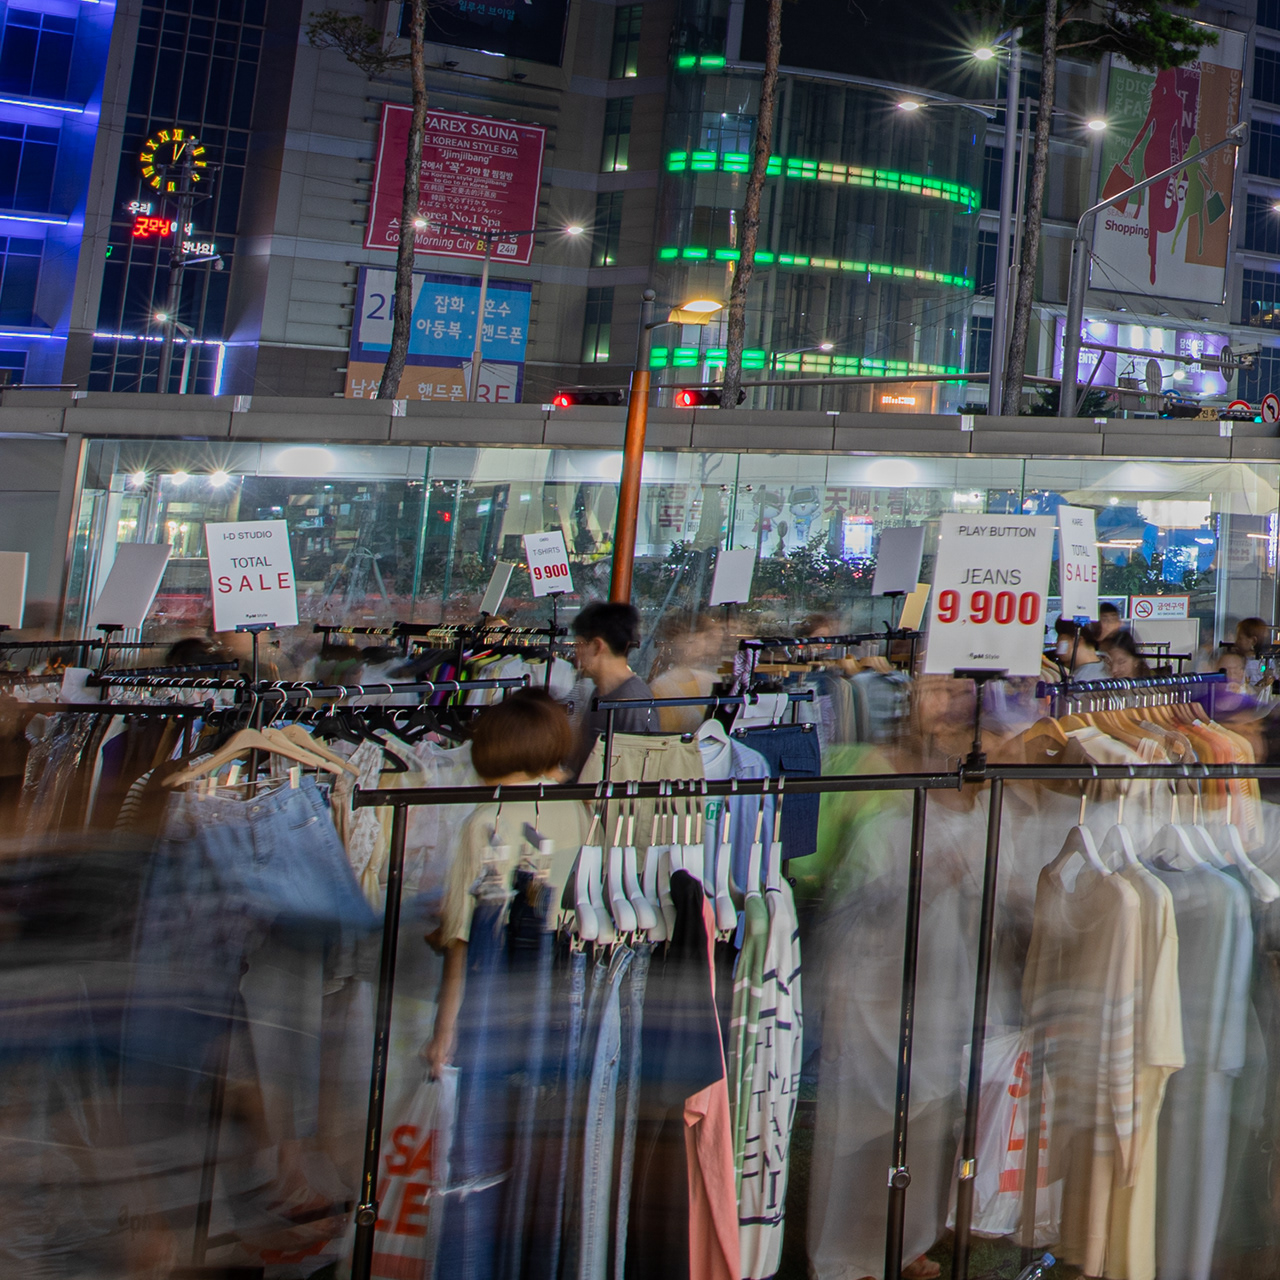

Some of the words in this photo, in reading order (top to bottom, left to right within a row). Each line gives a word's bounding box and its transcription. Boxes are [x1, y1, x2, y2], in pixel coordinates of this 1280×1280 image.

[471, 123, 519, 142] SAUNA
[432, 136, 470, 148] KOREAN
[473, 142, 499, 153] STYLE
[501, 146, 518, 156] SPA
[129, 201, 152, 216] 우리
[451, 211, 477, 223] No.1
[481, 216, 500, 227] Spa
[1105, 220, 1149, 238] Shopping
[385, 230, 400, 242] Go
[456, 238, 475, 251] City
[434, 295, 465, 314] 잡화
[484, 299, 511, 317] 혼수
[416, 319, 462, 339] 아동복
[481, 323, 523, 345] 핸드폰
[418, 382, 464, 402] 핸드폰
[238, 530, 272, 540] STUDIO
[958, 526, 987, 536] PLAY
[990, 526, 1036, 538] BUTTON
[1072, 544, 1090, 557] TOTAL
[231, 556, 272, 568] TOTAL
[961, 568, 1022, 585] JEANS
[1066, 562, 1097, 583] SALE
[218, 572, 290, 593] SALE
[938, 589, 1042, 626] 9,900
